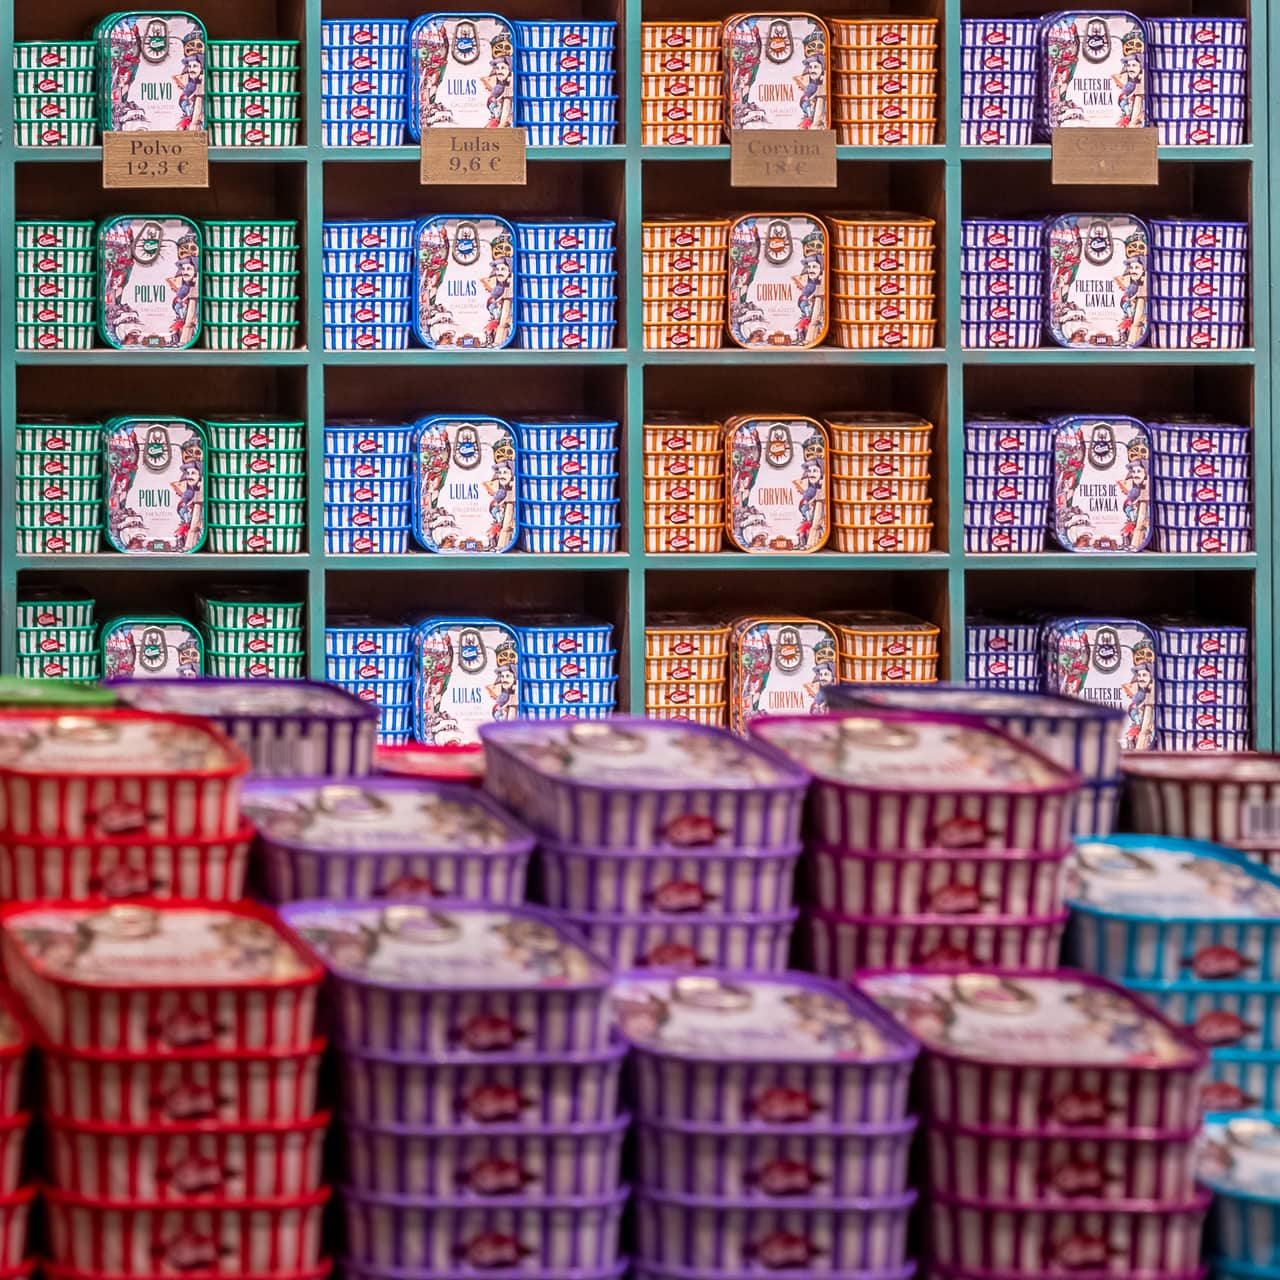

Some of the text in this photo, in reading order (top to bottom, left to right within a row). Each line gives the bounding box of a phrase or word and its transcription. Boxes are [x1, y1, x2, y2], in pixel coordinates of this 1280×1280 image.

[141, 83, 172, 101] POLVO
[447, 80, 476, 95] LULAS
[1073, 78, 1112, 91] FILETES DE
[758, 85, 794, 102] CORVINA
[1083, 93, 1113, 106] CAVALA
[130, 140, 182, 155] Polvo
[451, 137, 500, 152] Lulas
[749, 141, 820, 155] Corvina
[128, 161, 189, 176] 12,3 €
[449, 157, 501, 173] 9,6 €
[135, 285, 165, 303] POLVO
[448, 280, 477, 296] LULAS
[757, 284, 793, 302] CORVINA
[1076, 280, 1114, 293] FILETES DE
[1085, 294, 1115, 307] CAVALA
[139, 490, 170, 507] POLVO
[450, 484, 479, 500] LULAS
[758, 488, 793, 506] CORVINA
[1080, 485, 1118, 497] FILETES DE
[1089, 498, 1118, 512] CAVALA
[452, 688, 482, 704] LULAS
[769, 692, 805, 709] CORVINA
[1084, 688, 1122, 700] FILETES DE
